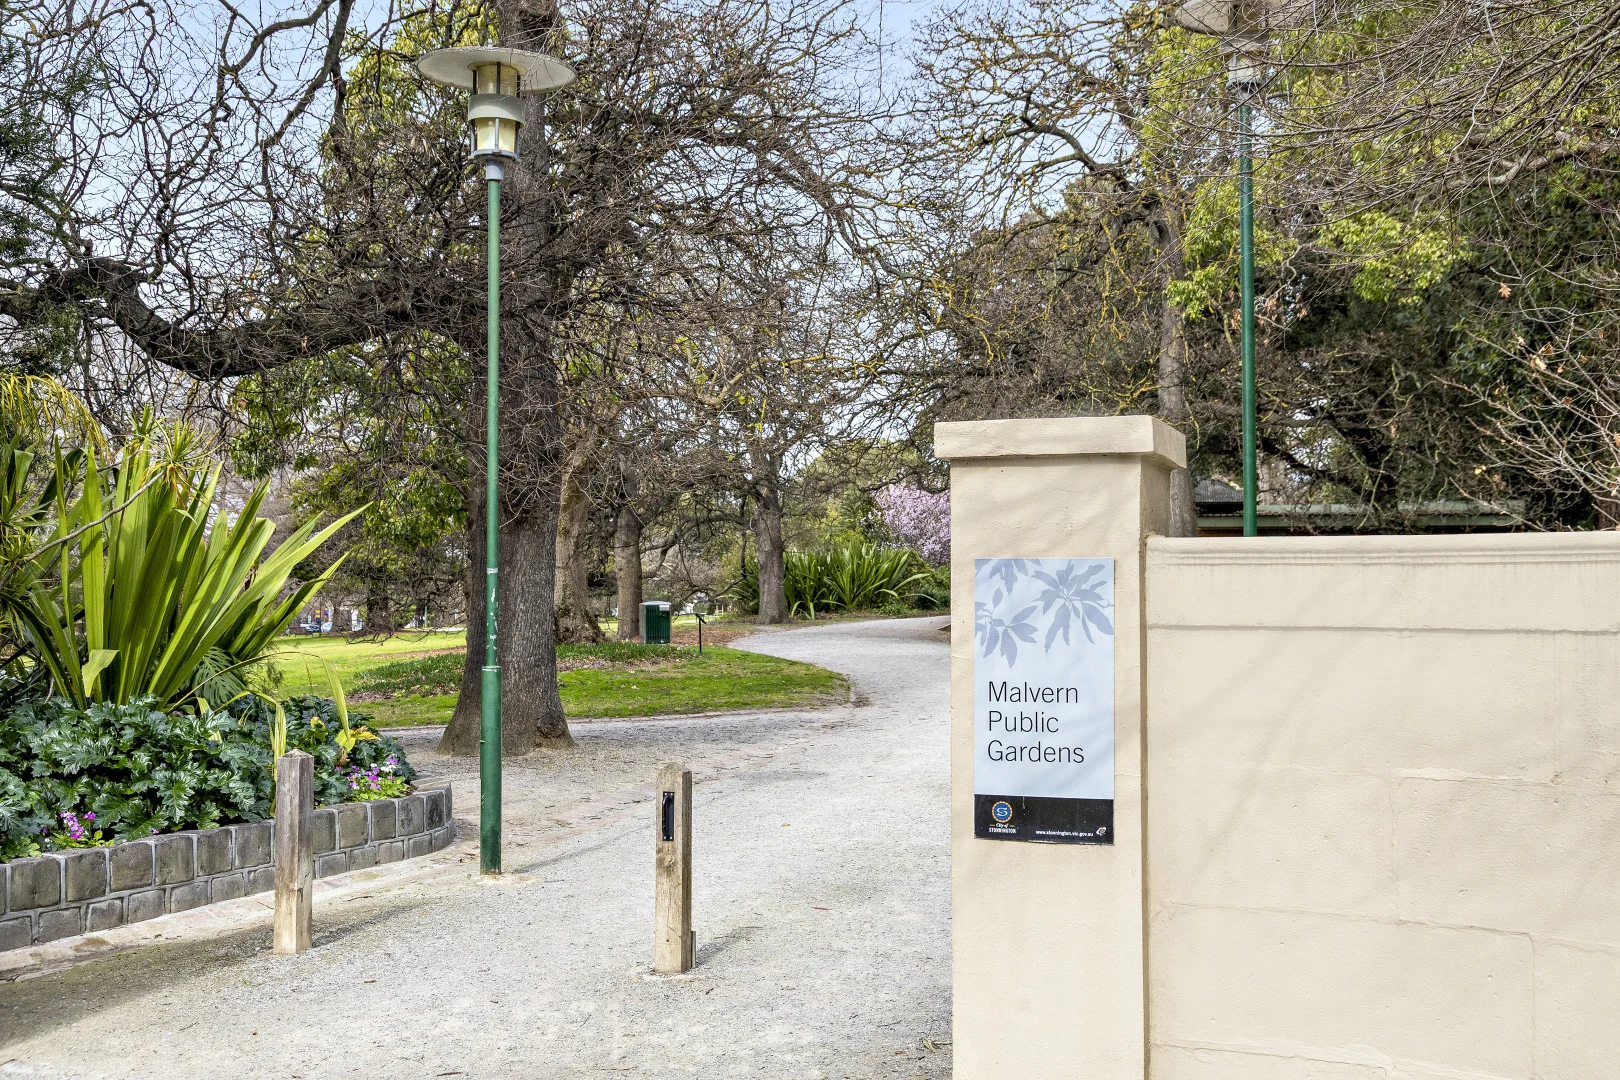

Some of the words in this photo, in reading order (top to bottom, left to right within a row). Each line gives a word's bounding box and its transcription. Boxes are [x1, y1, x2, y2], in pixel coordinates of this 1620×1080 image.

[989, 681, 1078, 703] Malvern
[989, 710, 1059, 732] Public
[988, 739, 1084, 763] Gardens
